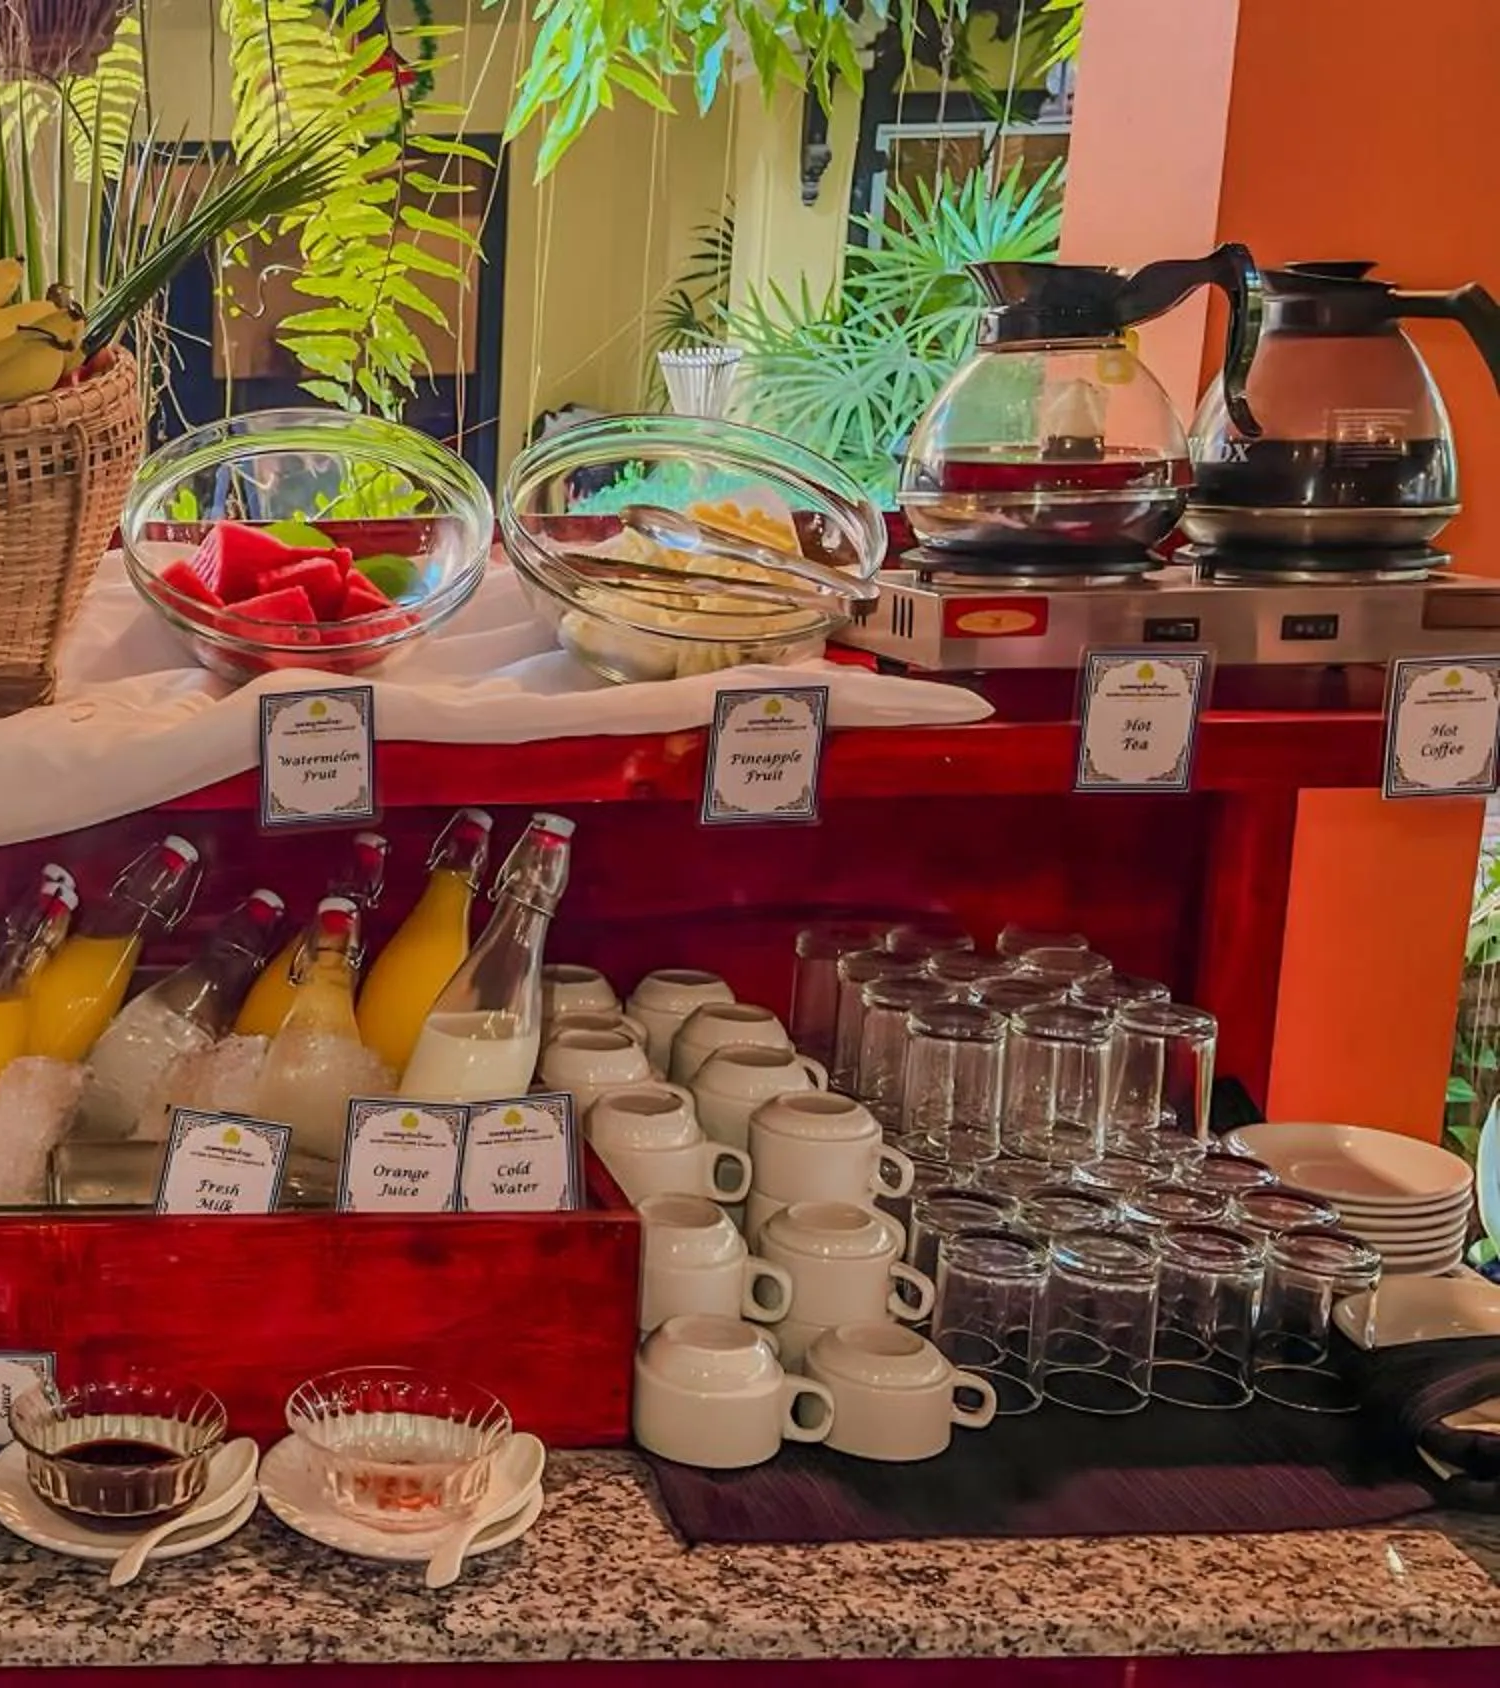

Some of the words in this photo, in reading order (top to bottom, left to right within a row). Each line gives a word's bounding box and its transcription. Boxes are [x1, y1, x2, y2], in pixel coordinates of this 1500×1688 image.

[1123, 719, 1153, 732] Hot
[1430, 723, 1460, 737] Hot
[1122, 736, 1149, 751] Tea
[1420, 740, 1465, 761] Coffee
[277, 749, 361, 767] Watermelon
[730, 748, 803, 769] Pineapple
[743, 769, 784, 785] Fruit
[372, 1163, 430, 1183] Orange
[496, 1160, 532, 1178] Cold
[194, 1178, 242, 1197] Fresh
[376, 1183, 420, 1198] Juice
[490, 1181, 539, 1196] Water
[195, 1197, 234, 1213] Milk
